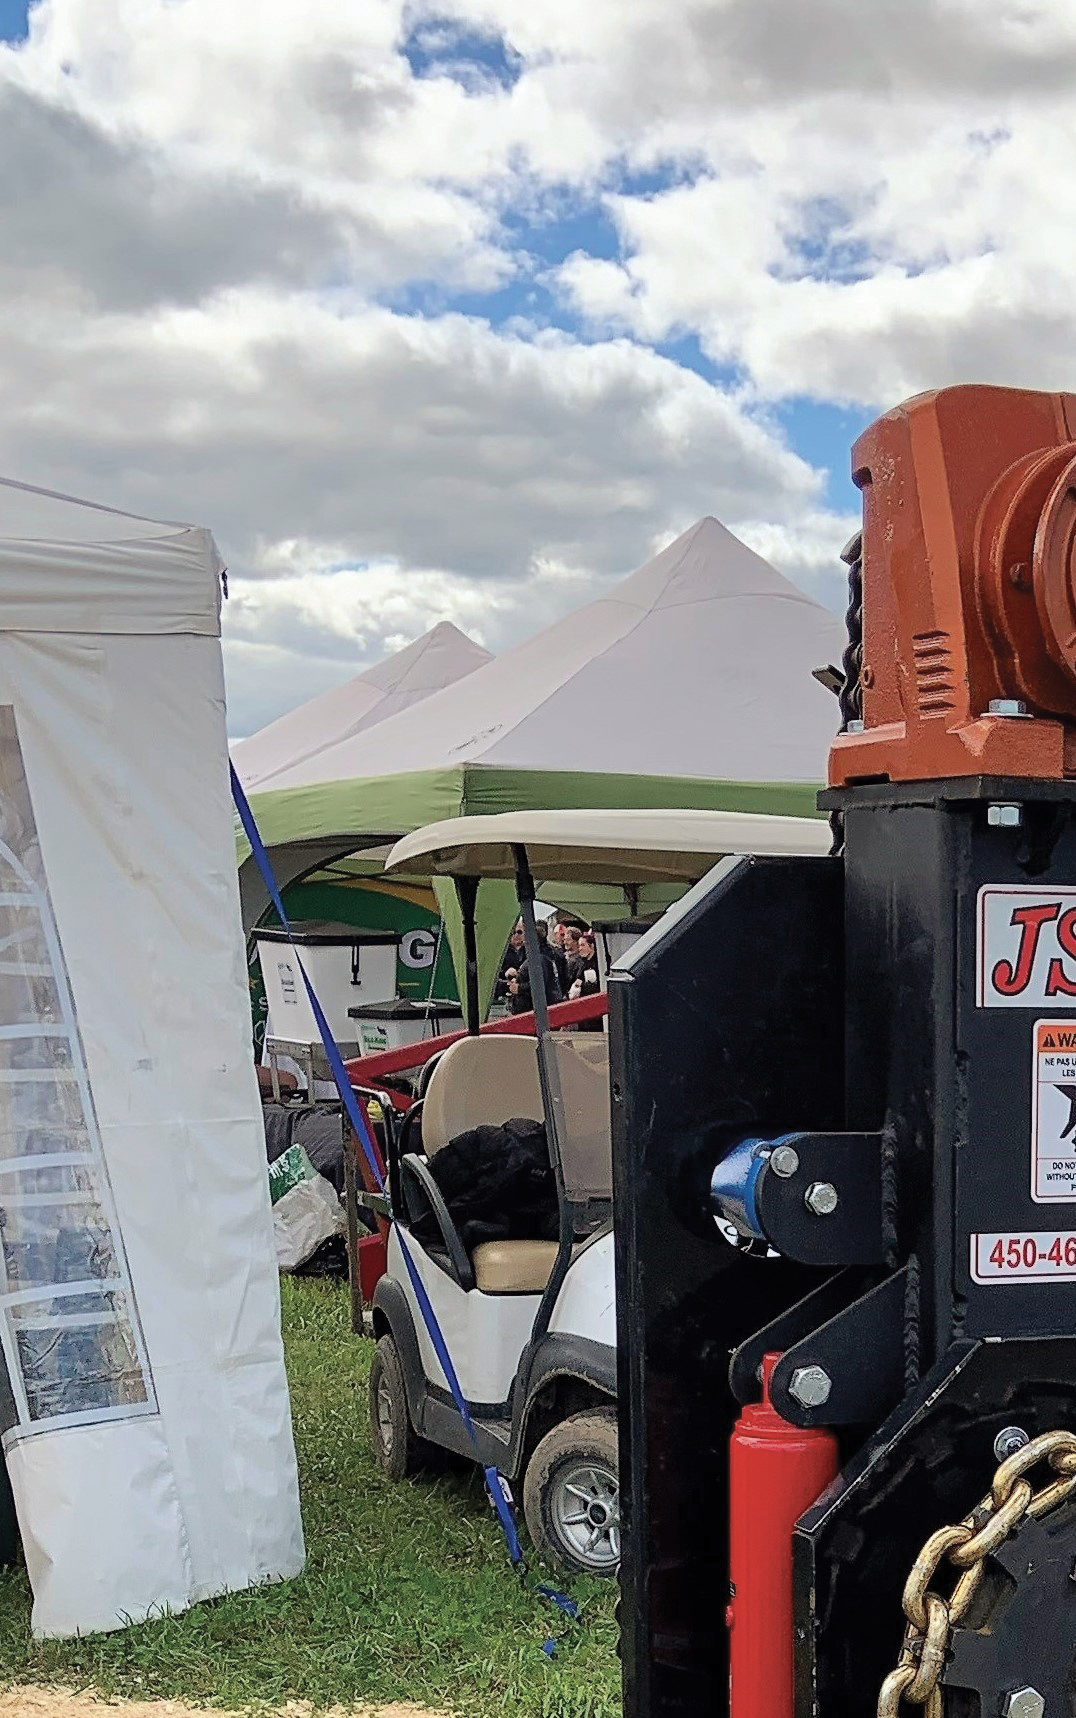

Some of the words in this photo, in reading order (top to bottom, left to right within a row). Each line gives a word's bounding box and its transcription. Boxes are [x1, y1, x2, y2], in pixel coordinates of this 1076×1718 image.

[1045, 1058, 1054, 1066] NE
[1056, 1058, 1070, 1066] PAS
[1062, 1069, 1076, 1077] LES
[1052, 1162, 1064, 1170] DO
